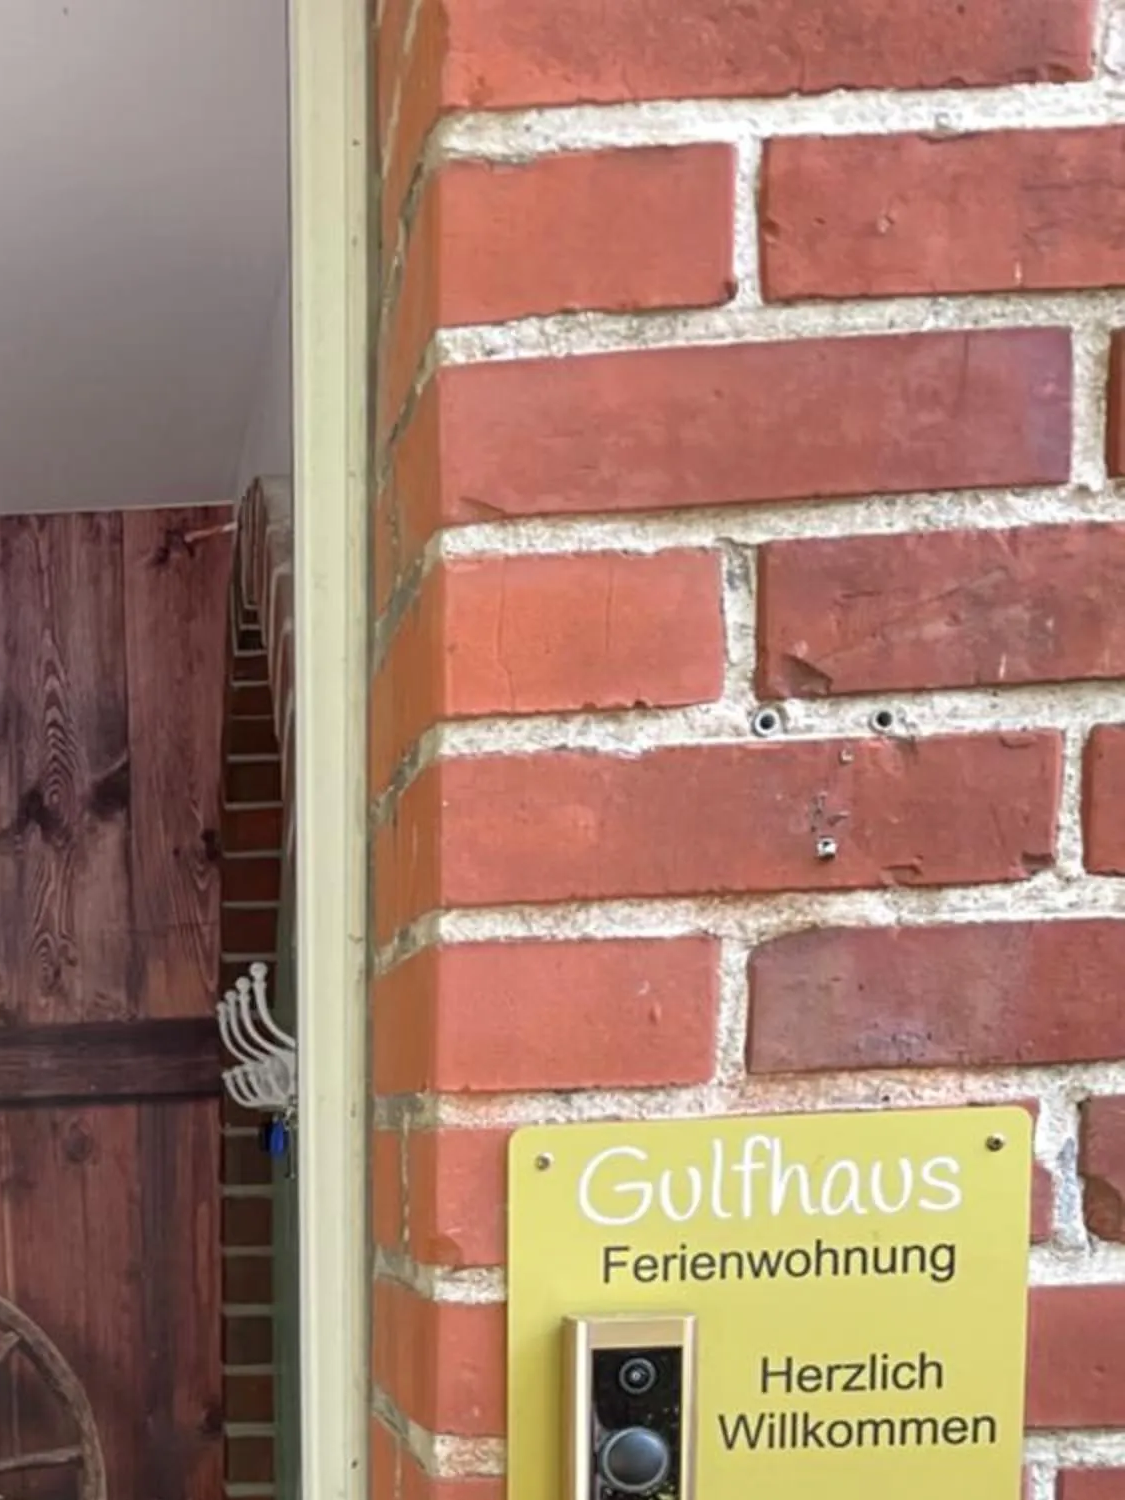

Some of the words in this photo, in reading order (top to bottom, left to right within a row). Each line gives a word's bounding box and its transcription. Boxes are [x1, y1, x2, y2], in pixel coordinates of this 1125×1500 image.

[578, 1134, 962, 1226] Gulfhaus
[602, 1239, 957, 1284] Ferienwohnung
[760, 1352, 944, 1394] Herzlich
[718, 1411, 997, 1450] Willkommen
